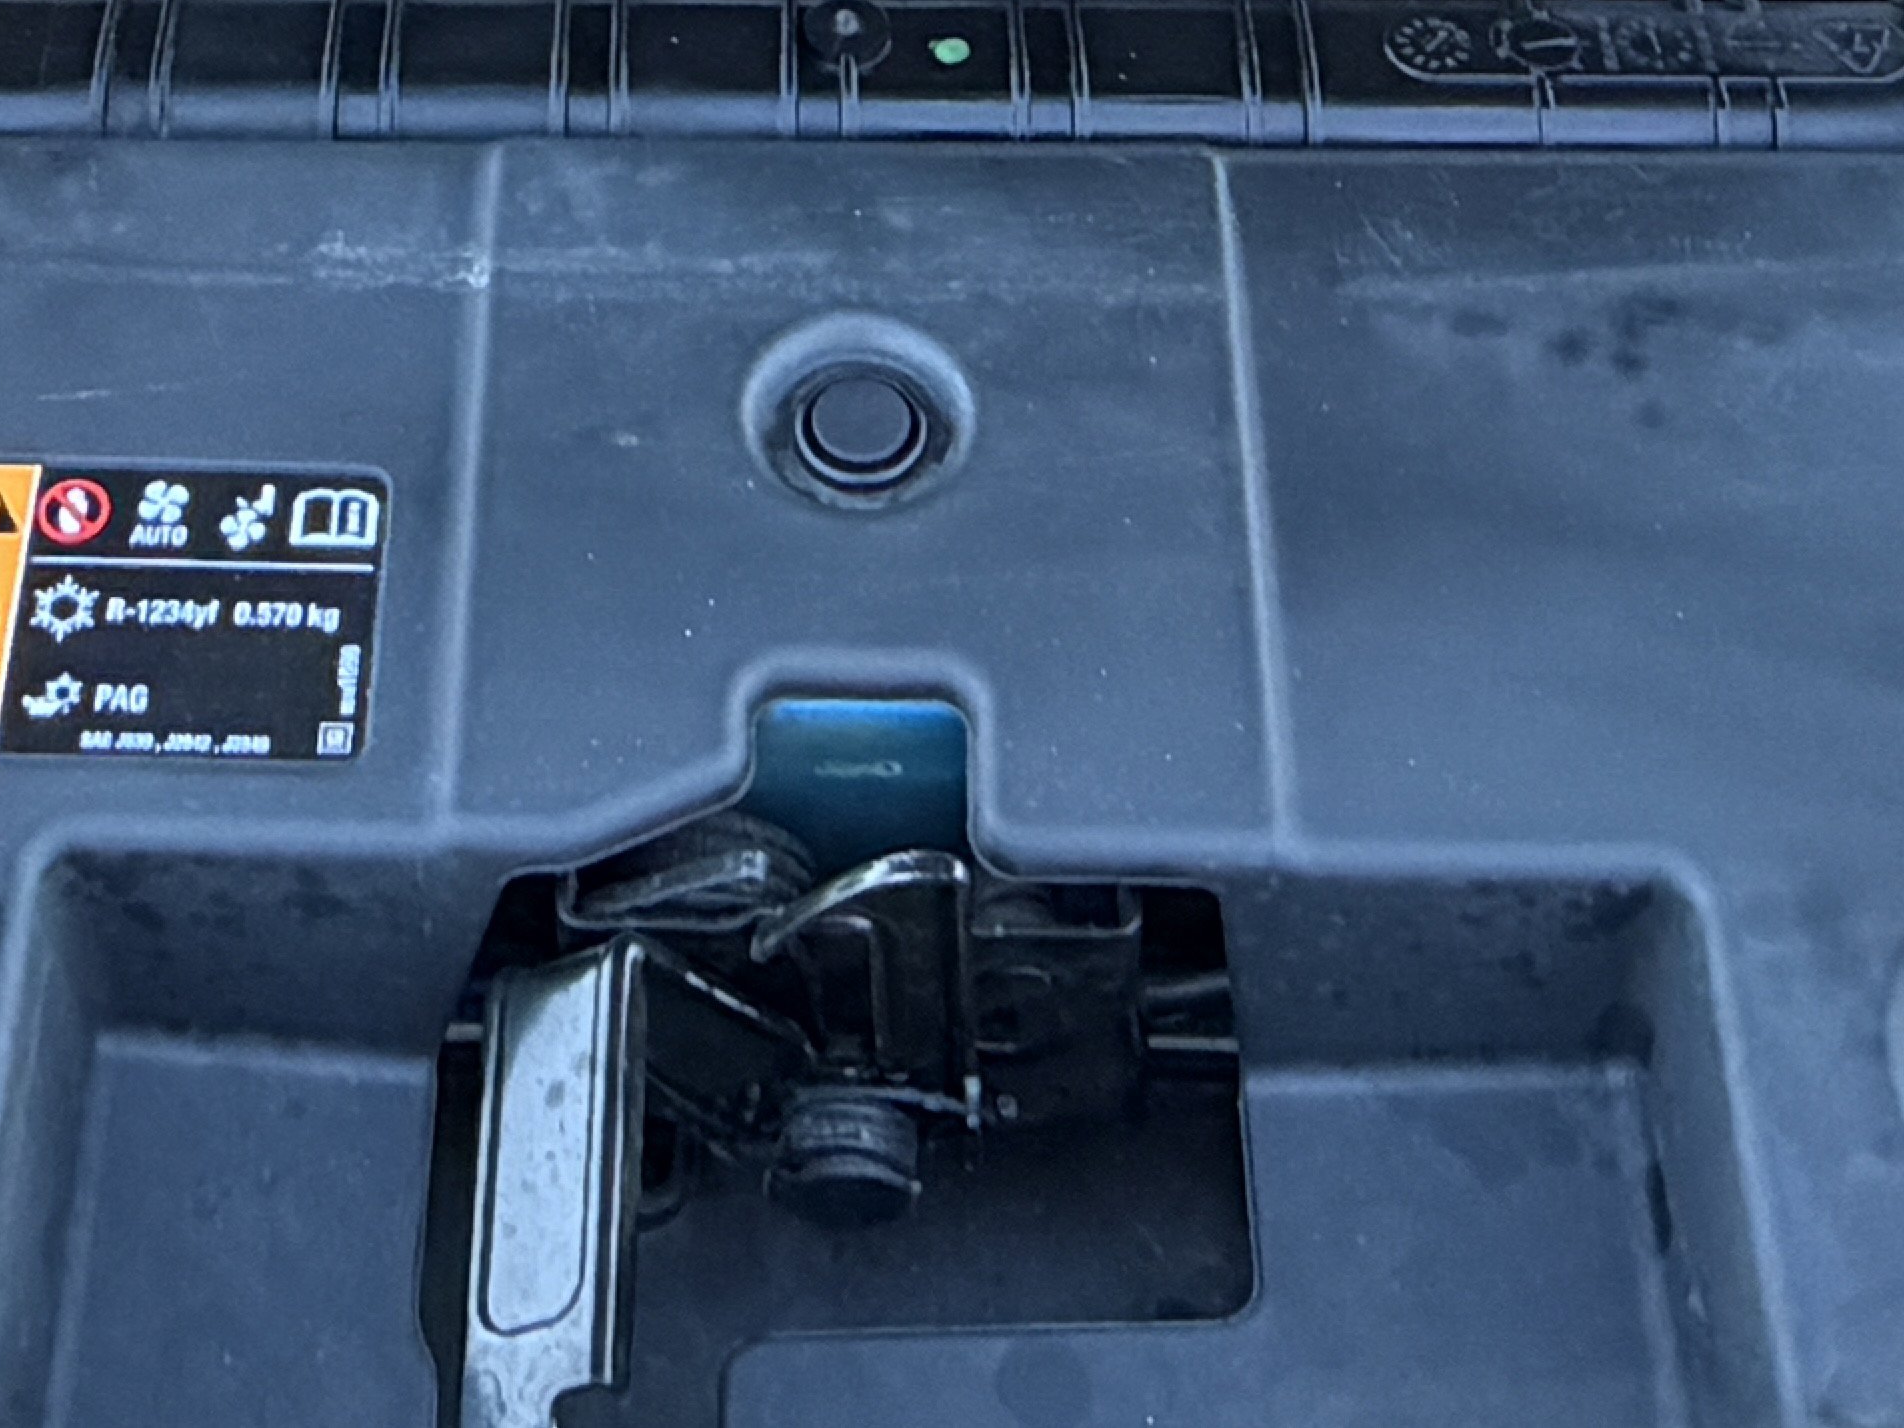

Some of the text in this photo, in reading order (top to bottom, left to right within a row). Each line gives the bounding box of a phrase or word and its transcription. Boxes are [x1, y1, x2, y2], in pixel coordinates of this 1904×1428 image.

[128, 523, 189, 548] AUTO
[104, 596, 341, 634] R-1234yf 0.570 kg
[93, 683, 150, 715] PAG
